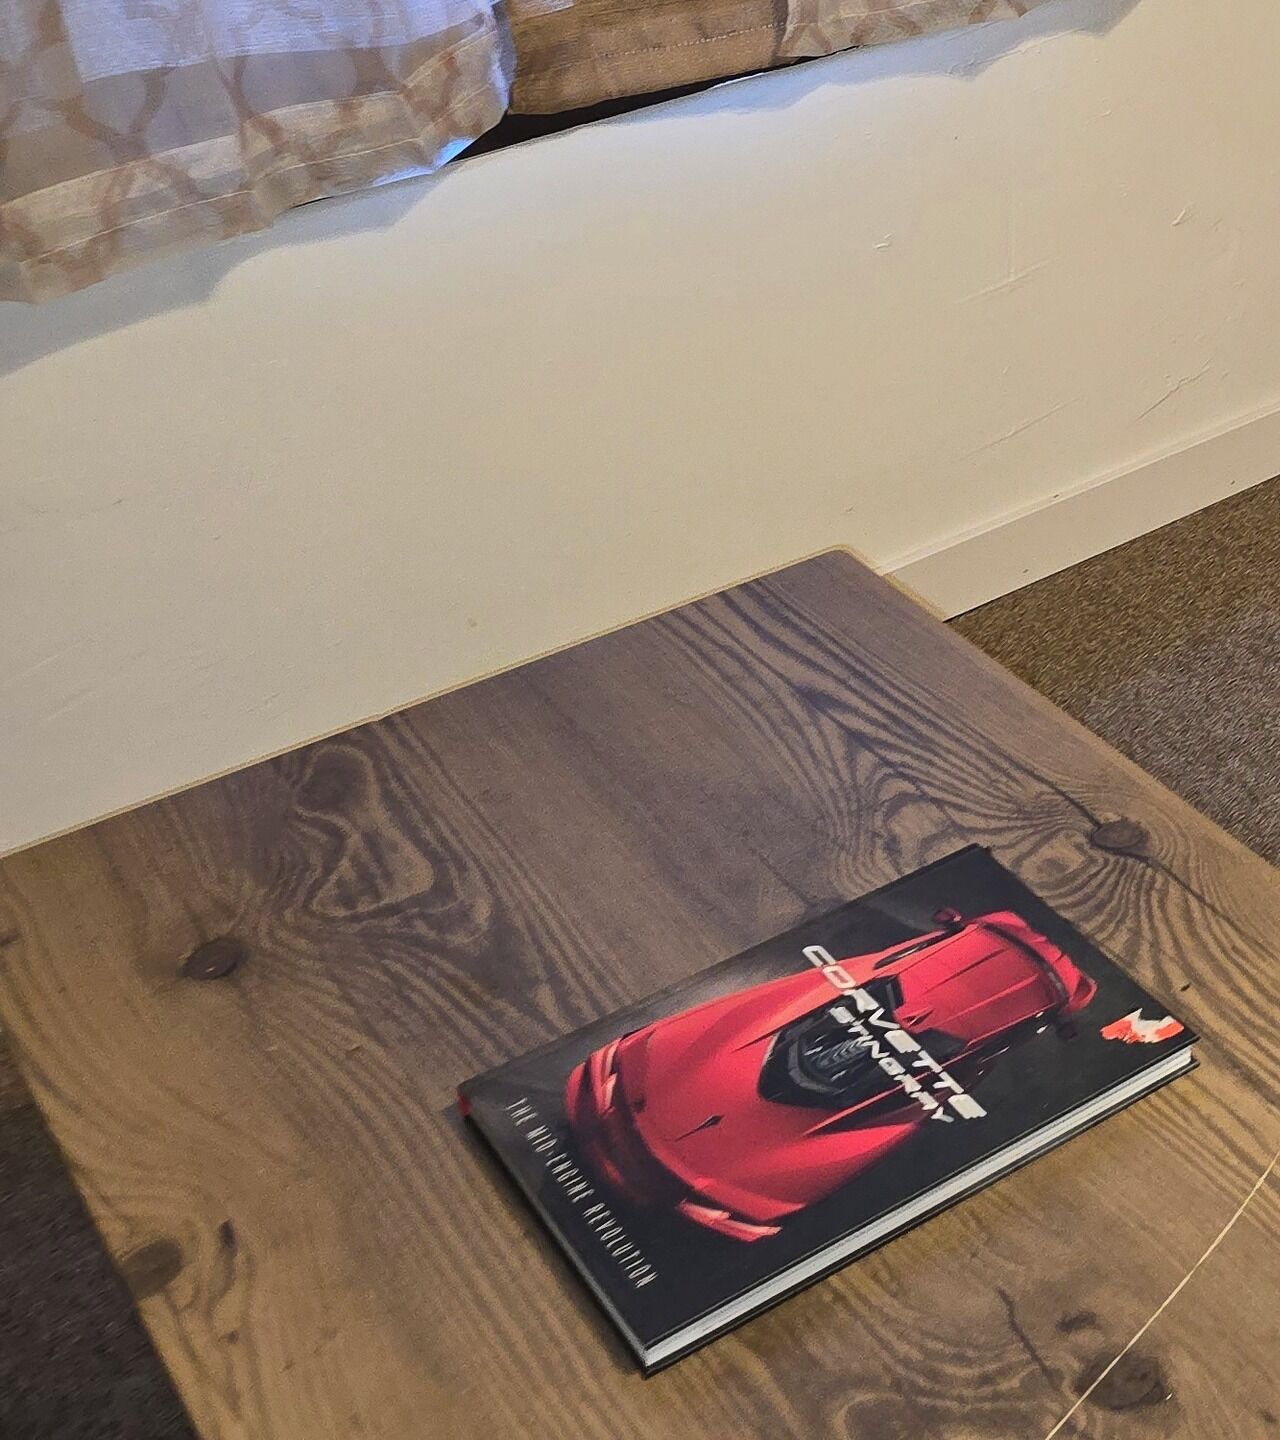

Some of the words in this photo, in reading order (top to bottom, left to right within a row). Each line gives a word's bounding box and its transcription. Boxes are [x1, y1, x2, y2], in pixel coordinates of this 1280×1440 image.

[802, 945, 988, 1120] CORVETTE
[829, 1006, 955, 1123] STINGRAY
[506, 1097, 538, 1127] THE
[527, 1124, 595, 1204] MID-ENGINE
[583, 1202, 658, 1289] REVOLUTION
